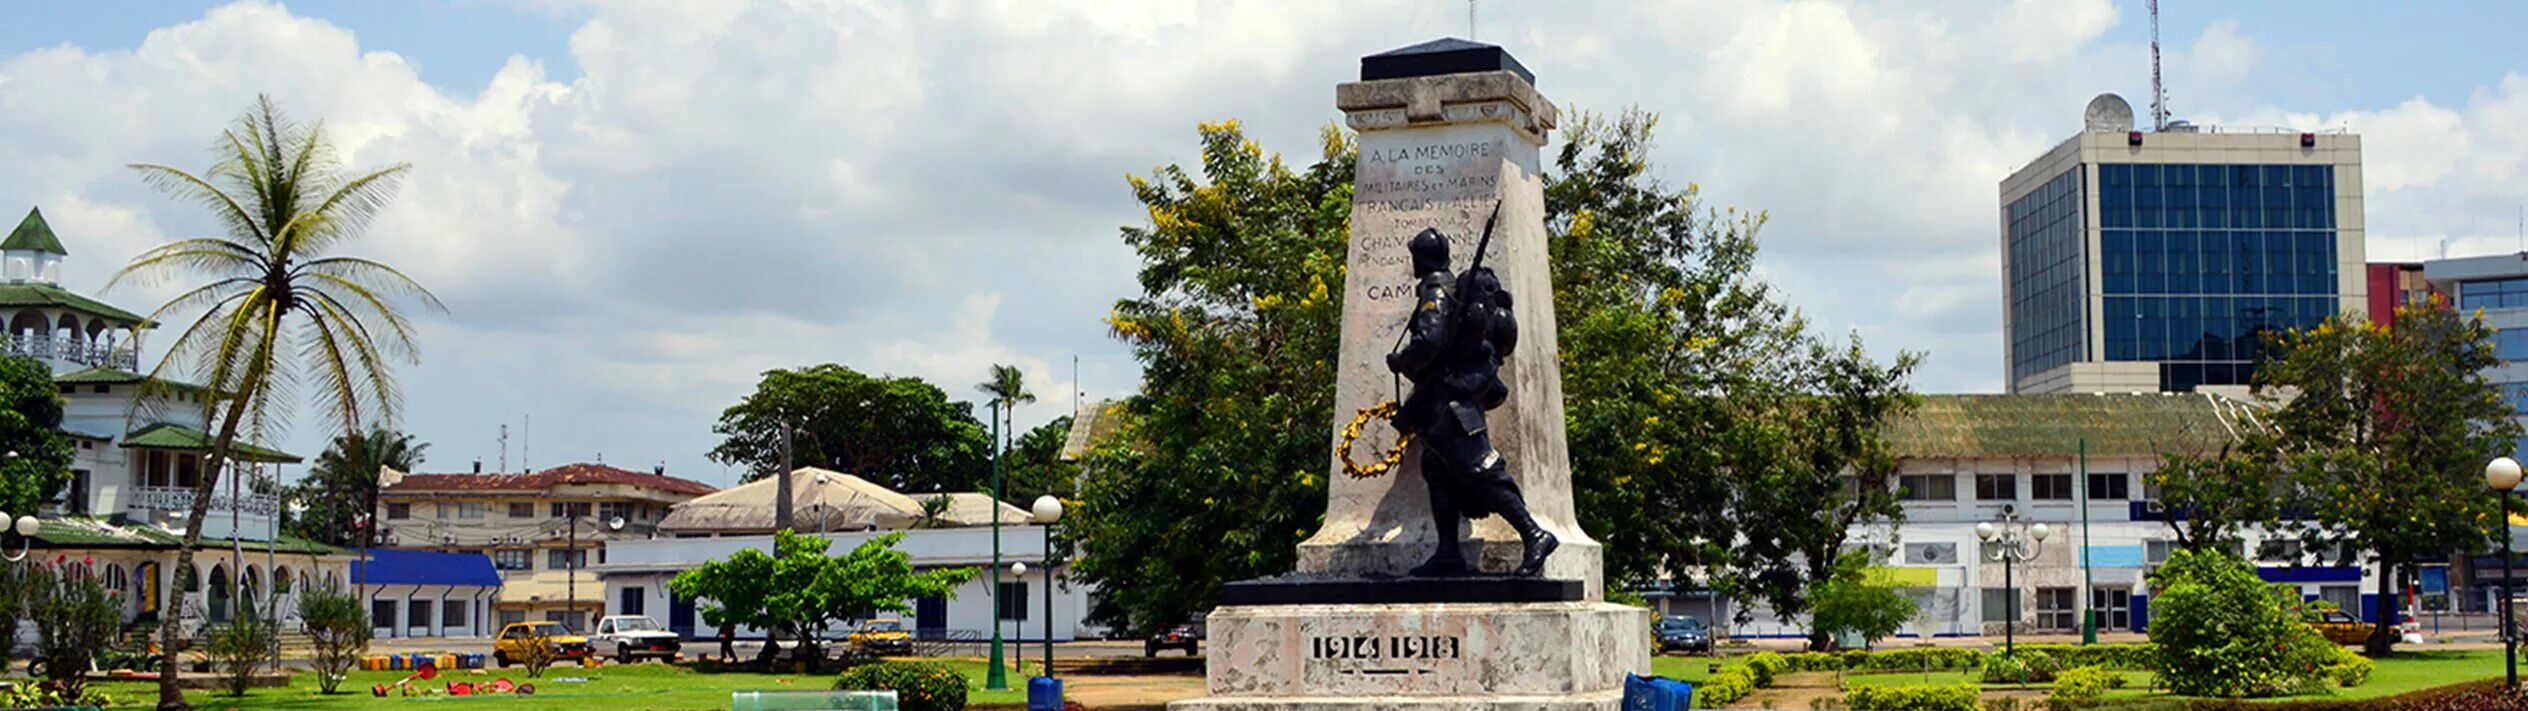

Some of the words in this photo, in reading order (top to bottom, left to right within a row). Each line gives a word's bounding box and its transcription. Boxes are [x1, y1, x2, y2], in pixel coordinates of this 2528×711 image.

[1388, 148, 1409, 162] LA
[1415, 143, 1489, 160] MEMOIRE
[1447, 175, 1496, 190] MARINS
[1367, 284, 1414, 301] CAM
[1391, 636, 1459, 659] 1918
